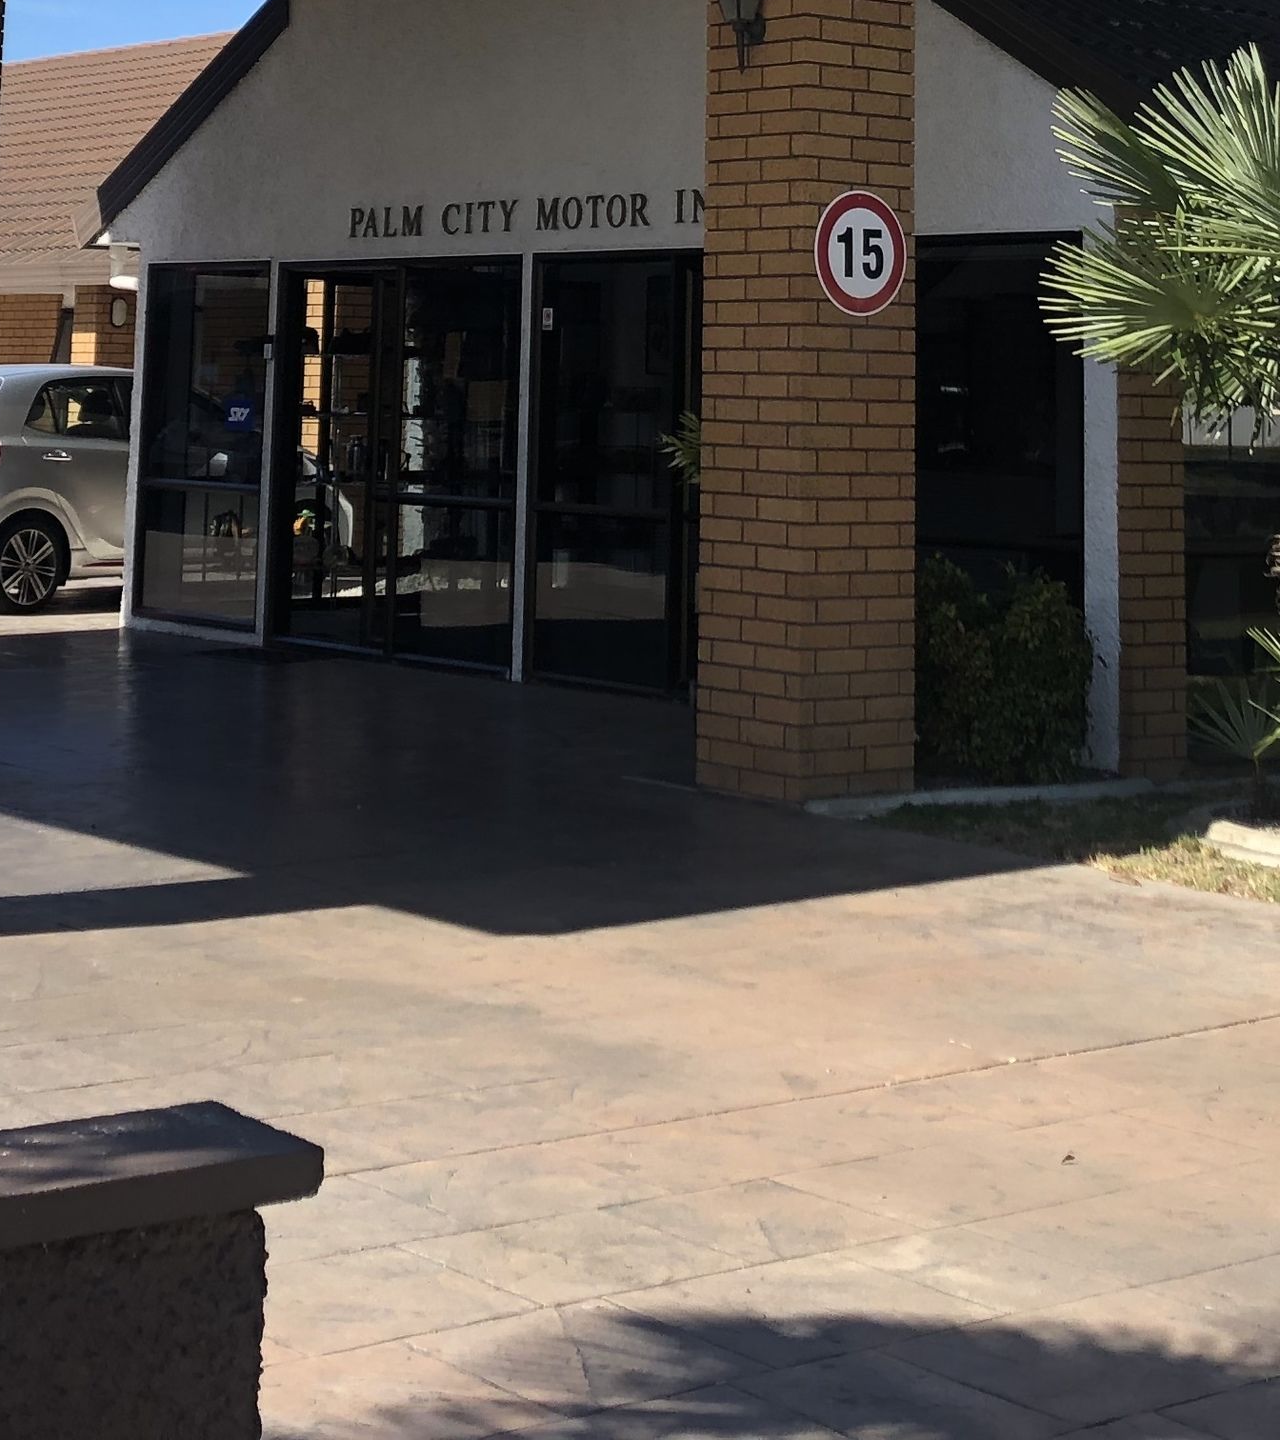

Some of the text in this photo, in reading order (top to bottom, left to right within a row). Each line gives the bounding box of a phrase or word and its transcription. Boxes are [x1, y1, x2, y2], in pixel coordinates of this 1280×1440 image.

[348, 204, 424, 239] PALM
[440, 198, 520, 236] CITY
[535, 192, 651, 231] MOTOR
[836, 226, 884, 280] 15
